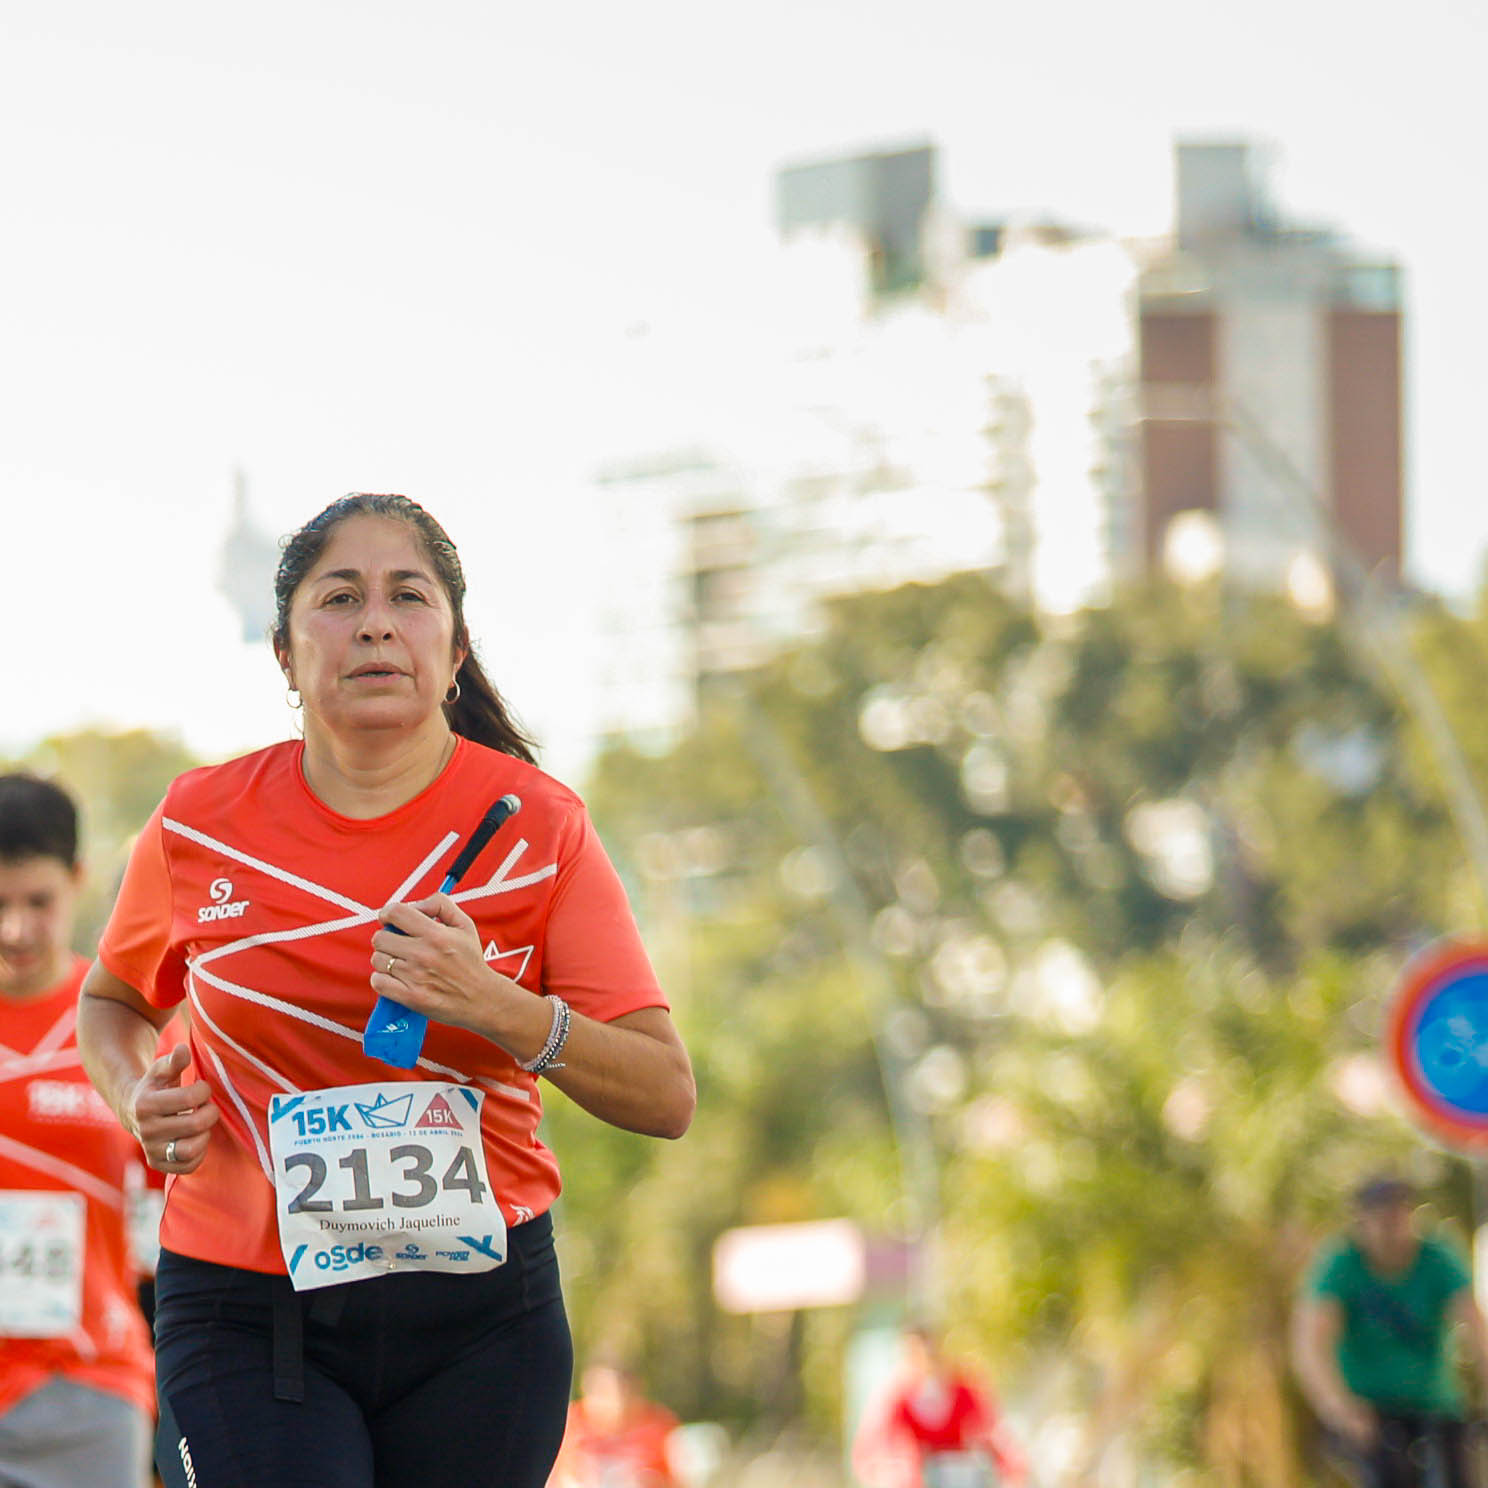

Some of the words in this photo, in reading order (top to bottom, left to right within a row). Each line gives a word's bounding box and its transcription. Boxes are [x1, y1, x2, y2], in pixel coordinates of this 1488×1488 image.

[292, 1104, 353, 1137] 15K
[426, 1109, 454, 1125] 15K
[284, 1144, 487, 1214] 2134
[319, 1217, 396, 1233] Duymovich
[399, 1214, 461, 1231] Jaqueline
[314, 1241, 384, 1271] osde
